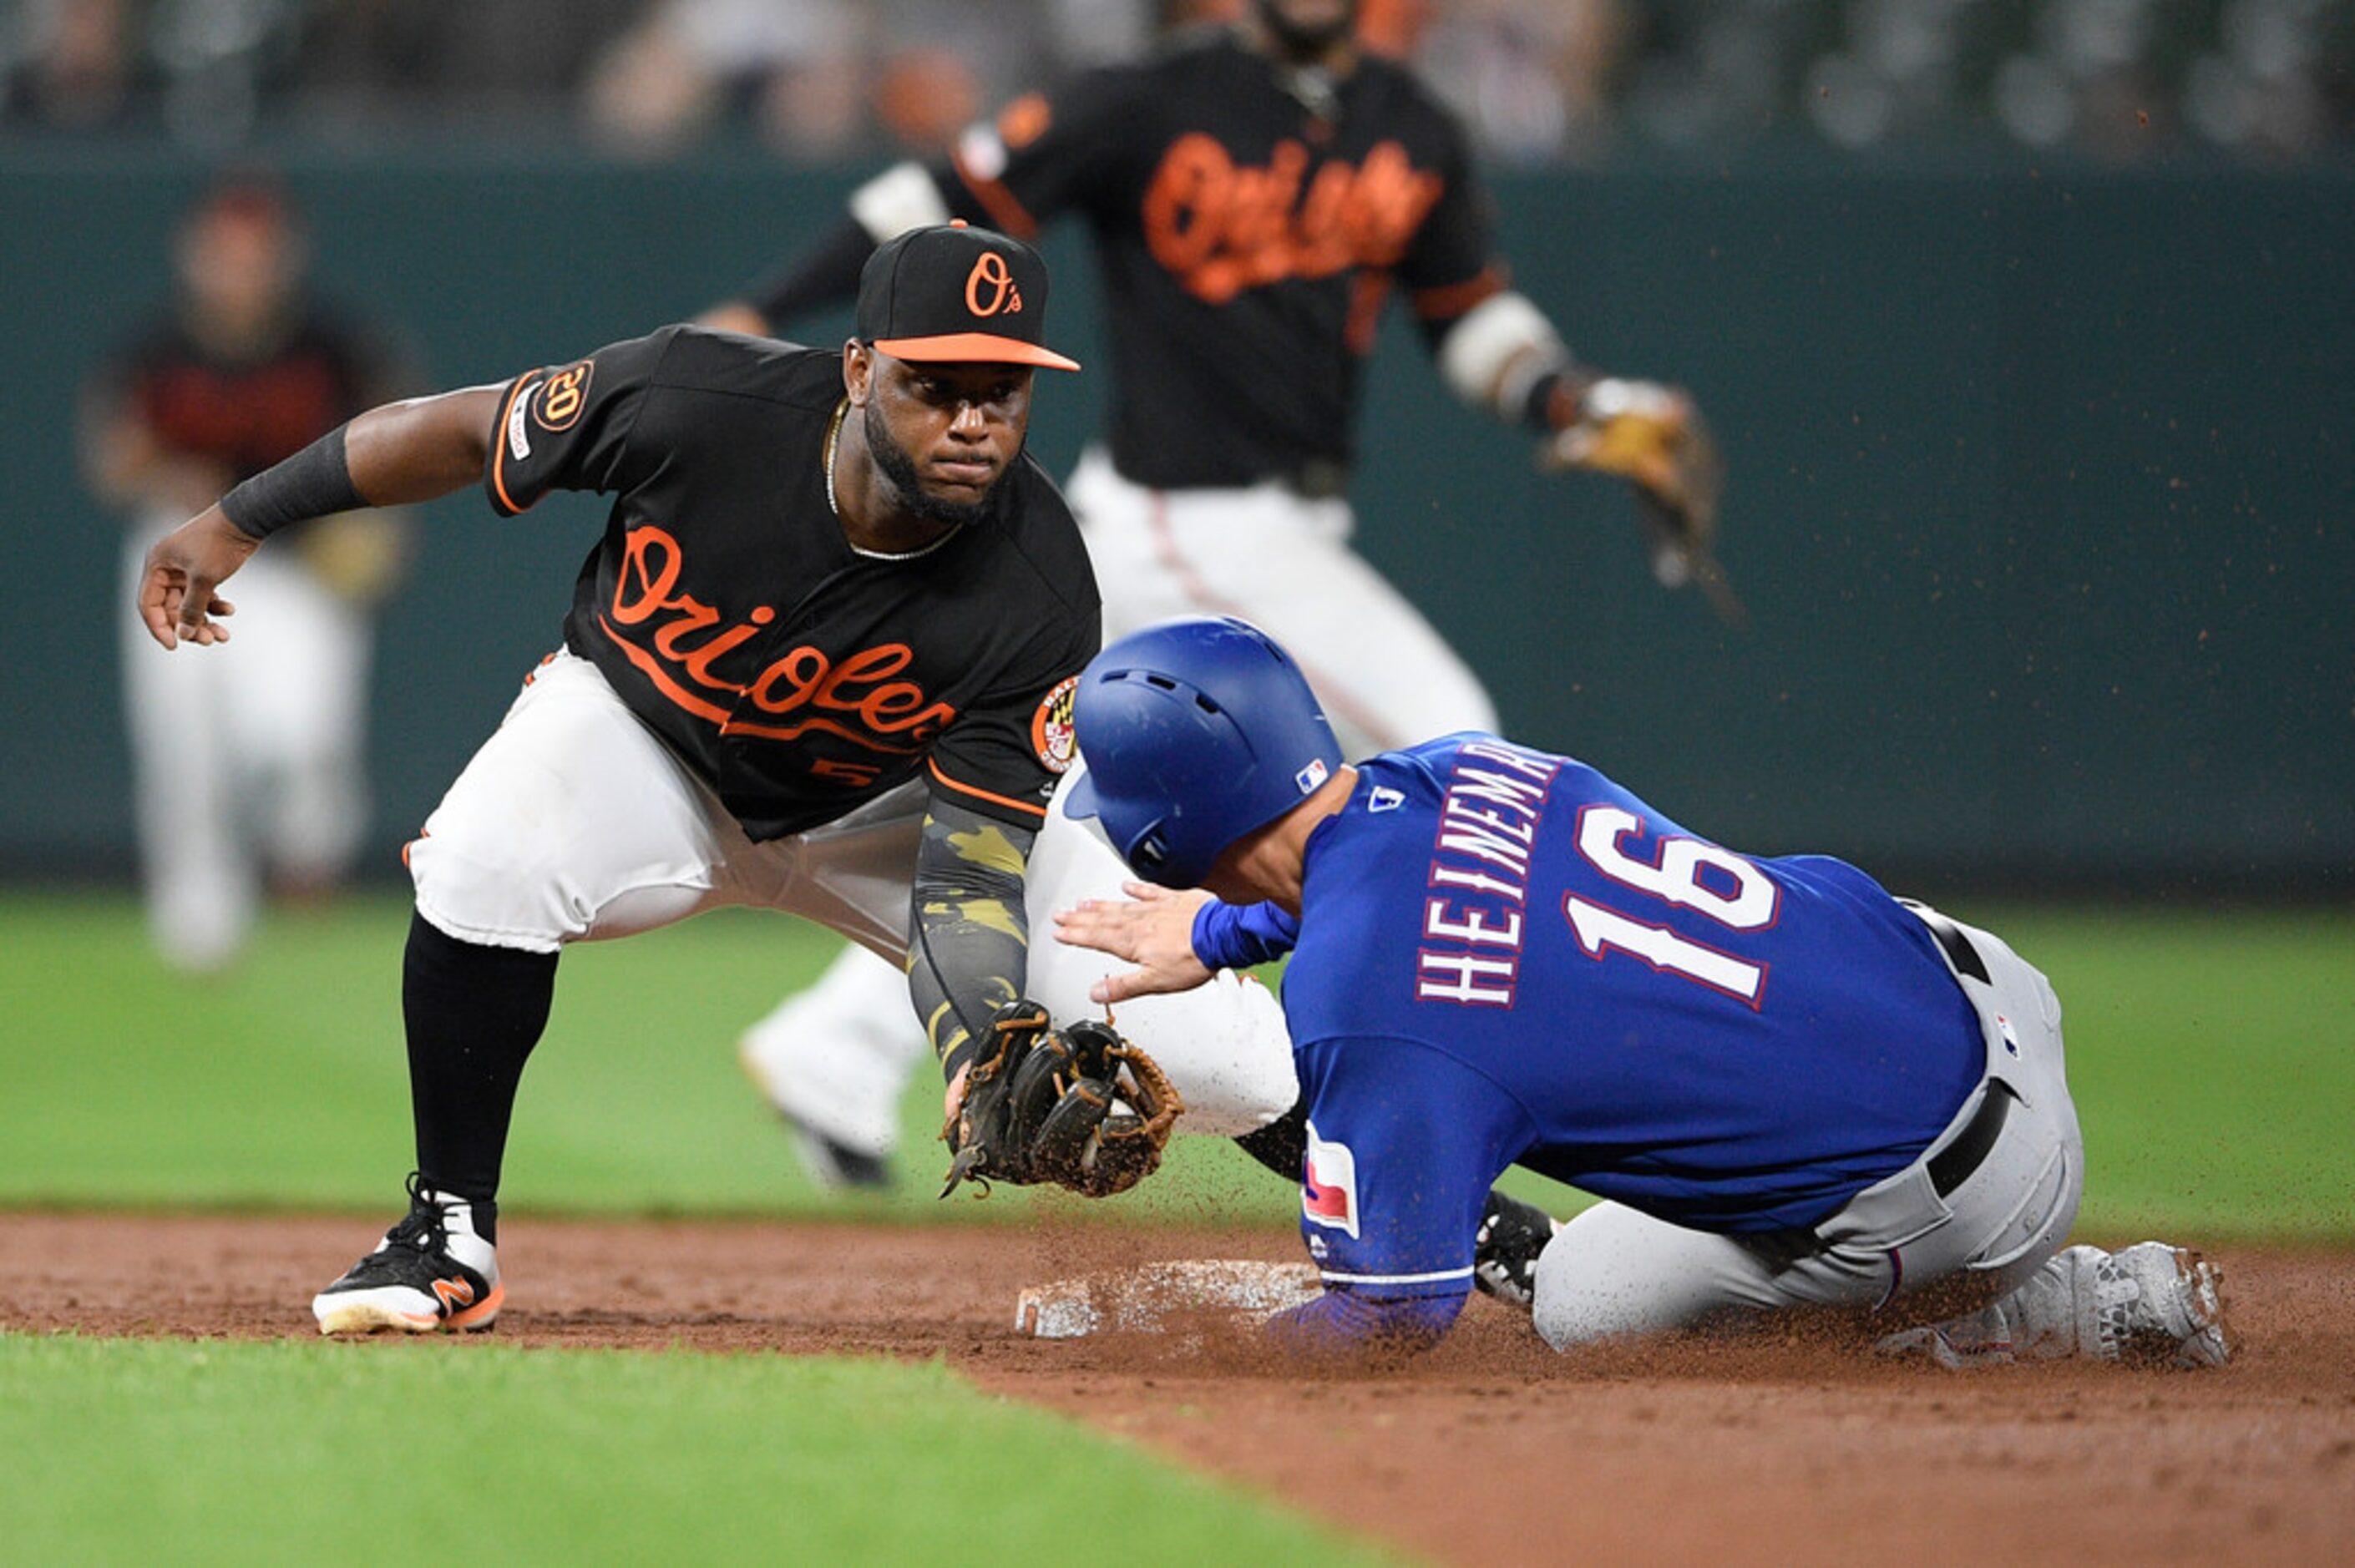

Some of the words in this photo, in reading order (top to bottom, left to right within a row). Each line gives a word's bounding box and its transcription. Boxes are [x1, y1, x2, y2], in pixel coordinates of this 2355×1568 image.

[965, 252, 1023, 316] O's
[545, 365, 585, 421] 20
[612, 525, 956, 741] Orioles
[1561, 802, 1783, 1013] 16
